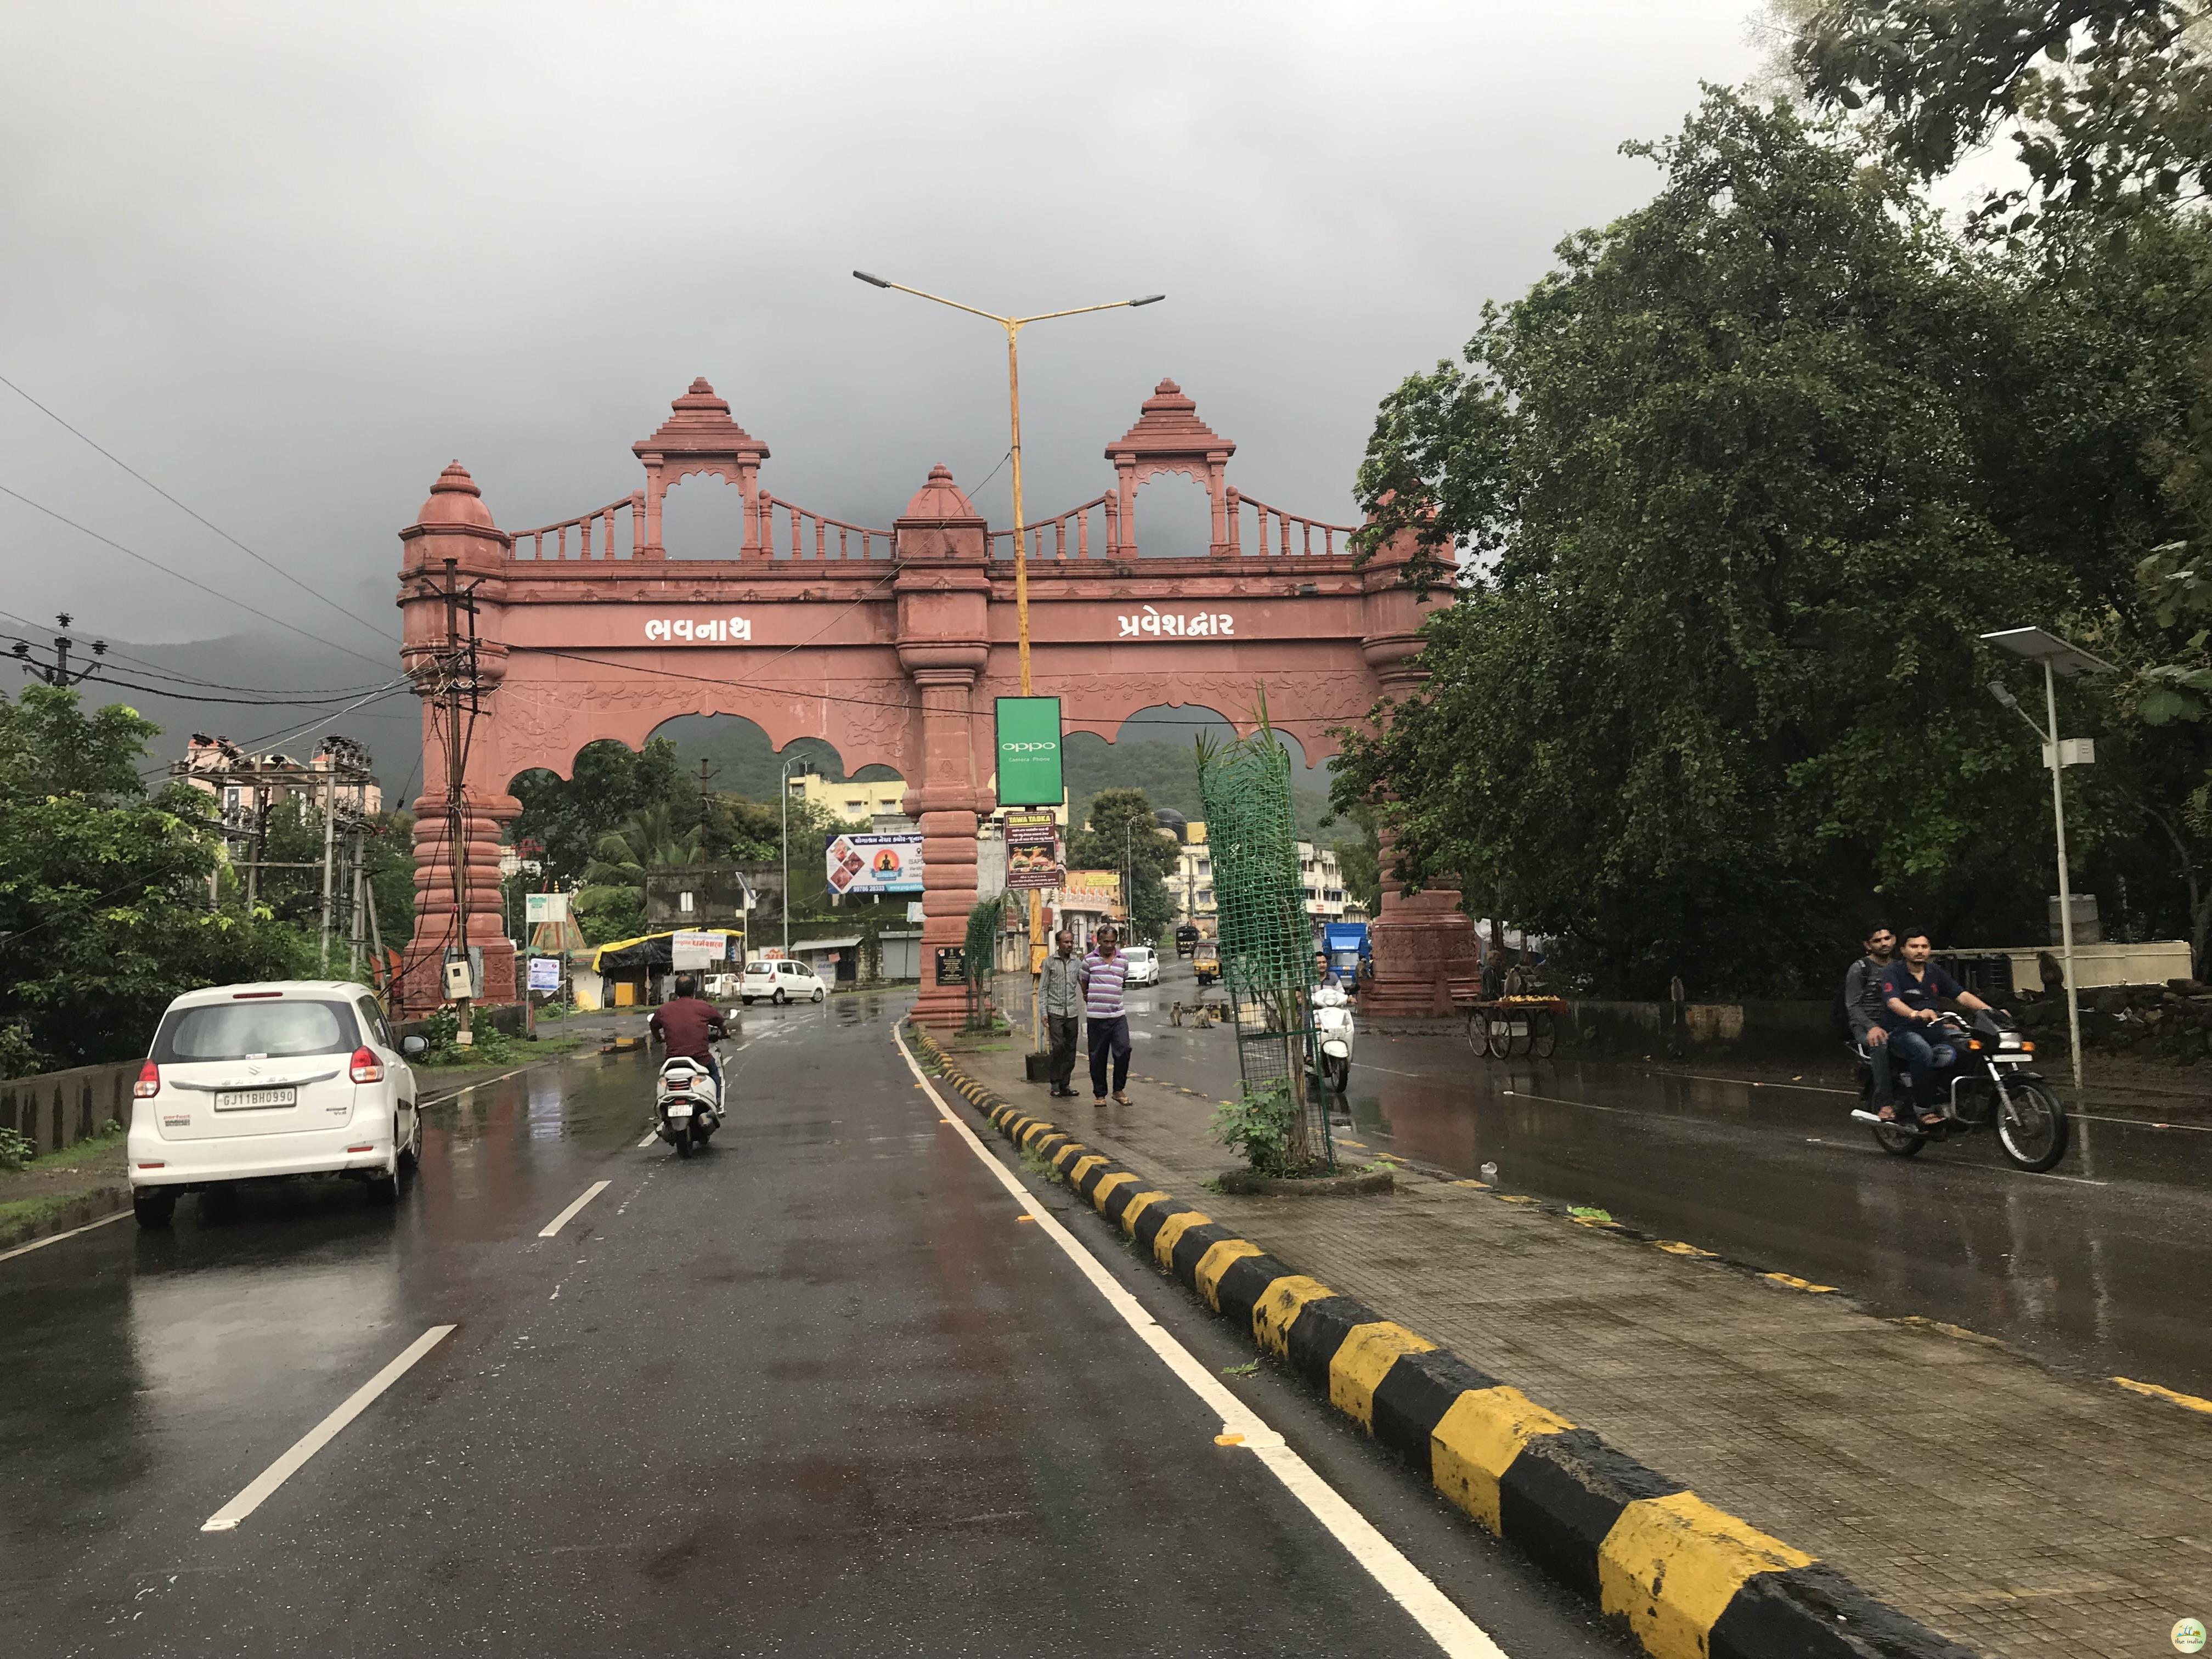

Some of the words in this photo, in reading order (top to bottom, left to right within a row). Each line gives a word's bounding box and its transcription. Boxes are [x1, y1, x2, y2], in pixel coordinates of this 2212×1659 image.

[645, 617, 751, 641] ભવનાથ
[1118, 604, 1234, 637] પ્રવેશદ્વાર
[692, 939, 724, 949] धर्मशाला
[224, 1091, 292, 1105] GJ11BH0990
